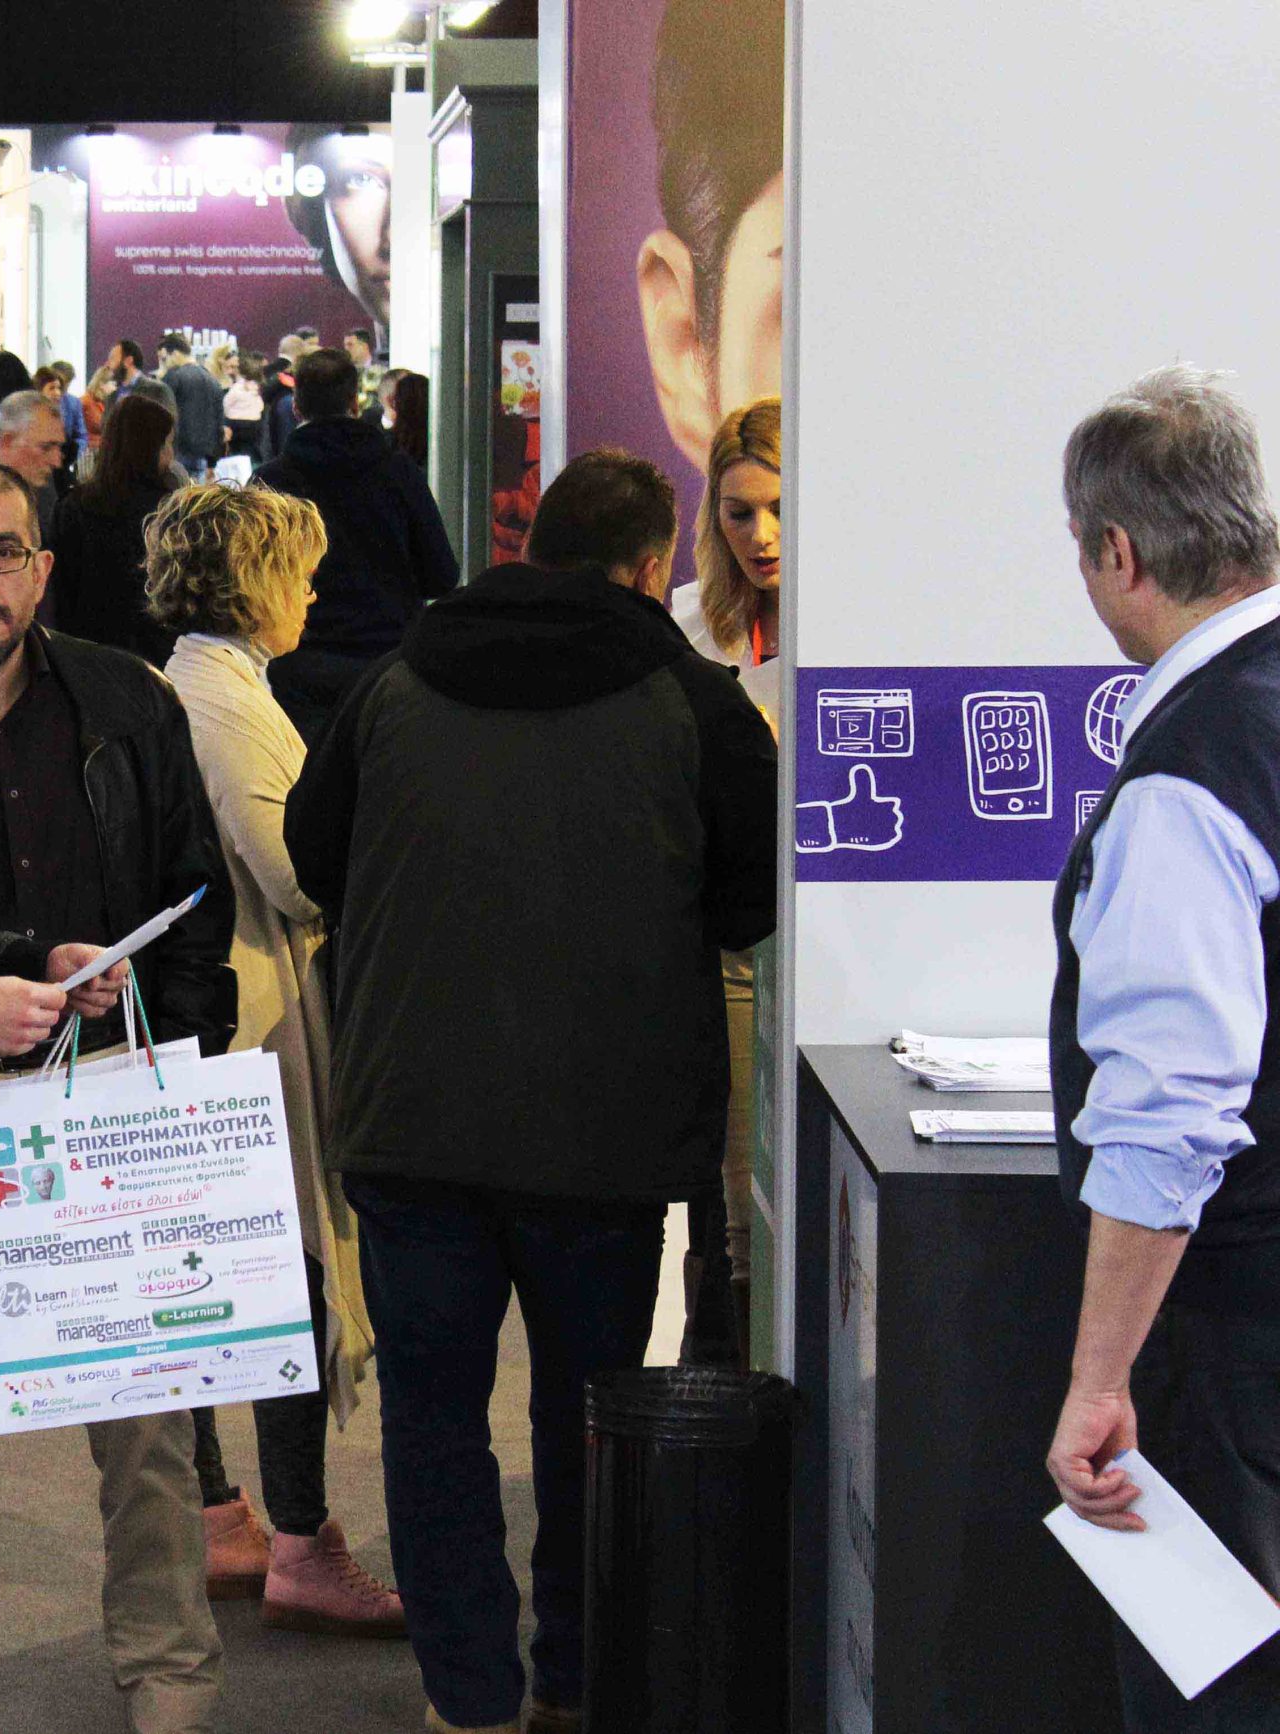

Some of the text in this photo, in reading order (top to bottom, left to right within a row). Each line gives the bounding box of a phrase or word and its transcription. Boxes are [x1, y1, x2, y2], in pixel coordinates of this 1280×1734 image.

[114, 244, 324, 261] supreme swiss dermotechnology
[90, 1105, 180, 1130] Διημερίδα
[200, 1095, 271, 1115] Έκθεση
[66, 1113, 273, 1153] ΕΠΙΧΕΙΡΗΜΑΤΙΚΟΤΗΤΑ
[69, 1131, 277, 1171] & ΕΠΙΚΟΙΝΩΝΙΑ ΥΓΕΙΑΣ
[91, 1203, 107, 1214] να
[143, 1209, 286, 1245] management
[35, 1289, 67, 1303] Learn
[84, 1280, 118, 1296] Invest
[160, 1305, 225, 1322] e-Learning
[57, 1313, 151, 1343] management
[21, 1376, 55, 1393] CSA
[78, 1368, 121, 1381] ISOPLUS
